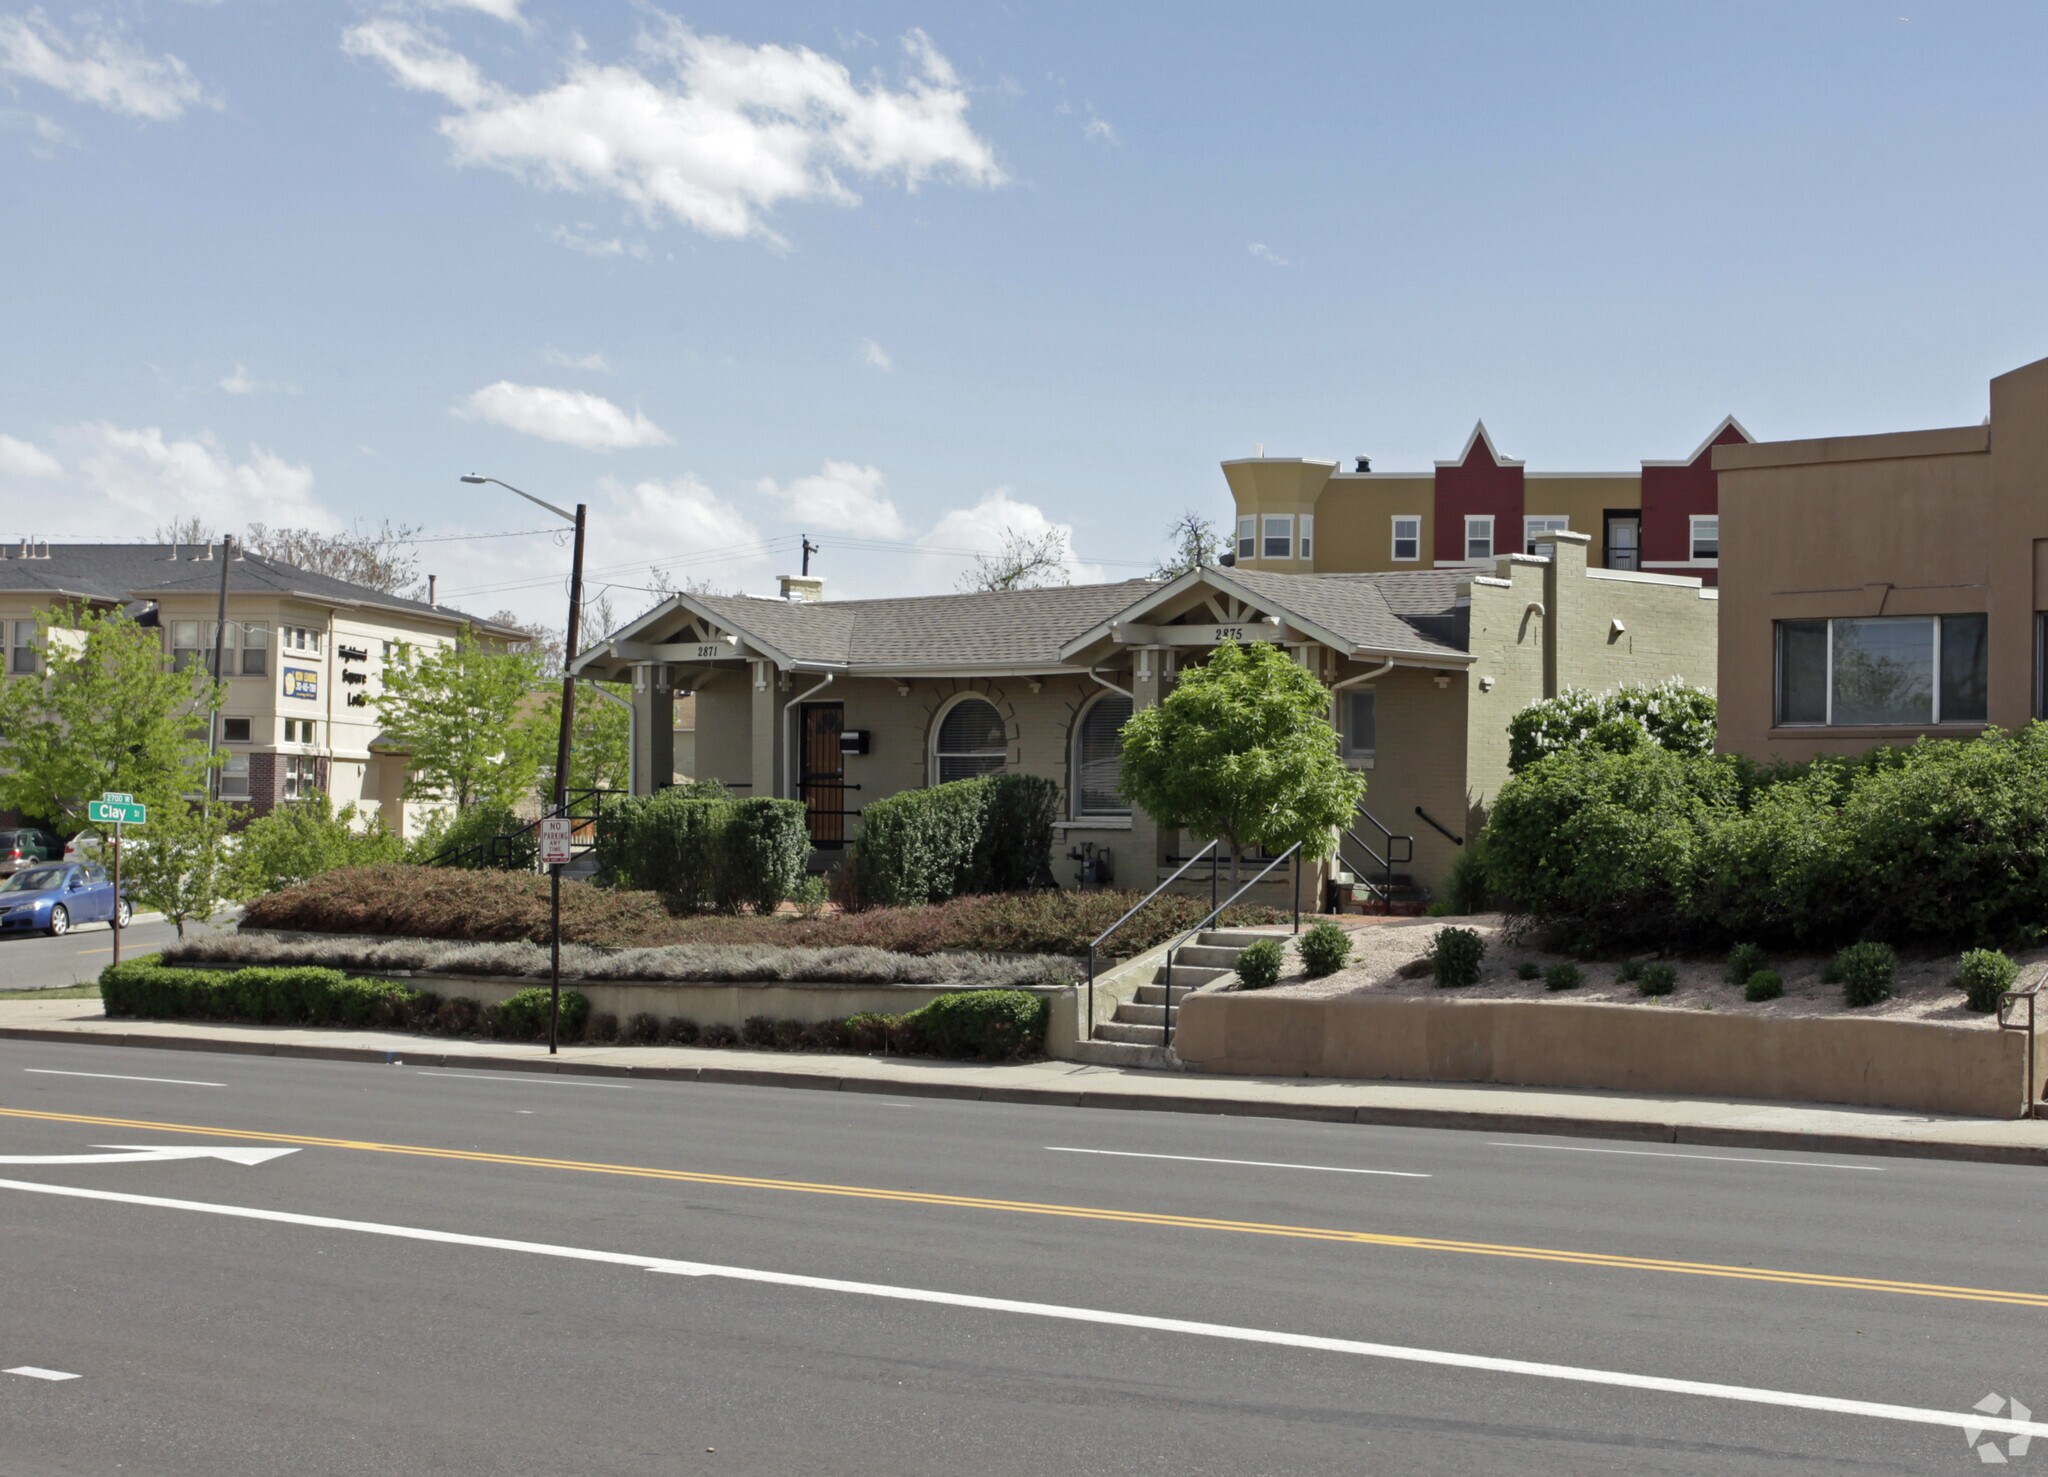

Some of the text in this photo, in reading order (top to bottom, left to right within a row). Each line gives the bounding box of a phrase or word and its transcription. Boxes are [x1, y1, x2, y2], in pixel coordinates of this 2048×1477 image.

[1215, 628, 1242, 640] 2875
[697, 646, 718, 657] 2871
[342, 668, 367, 685] Square
[100, 805, 126, 821] Clay
[550, 822, 561, 830] NO
[543, 832, 568, 840] PARKING
